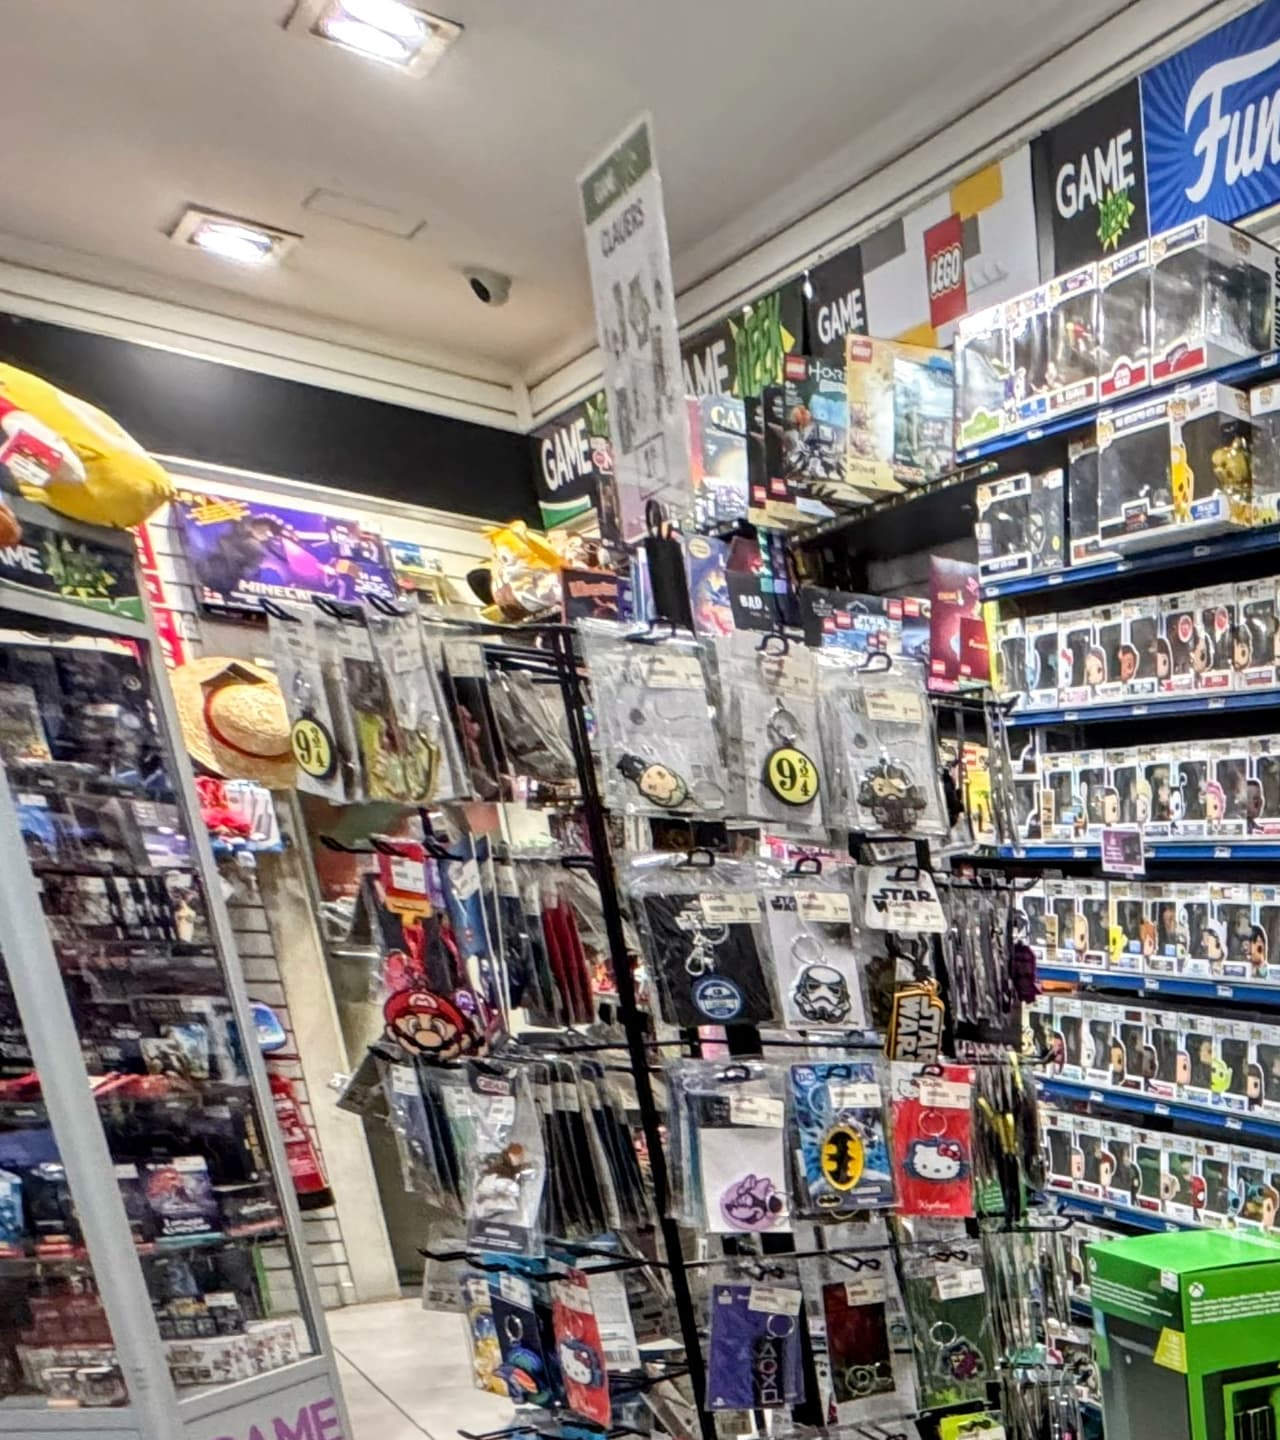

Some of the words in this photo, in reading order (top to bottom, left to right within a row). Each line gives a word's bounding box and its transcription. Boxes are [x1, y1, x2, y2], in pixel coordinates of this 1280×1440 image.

[1056, 129, 1135, 219] GAME
[931, 247, 963, 292] LEGO
[818, 288, 863, 344] GAME
[541, 418, 592, 491] GAME
[873, 888, 935, 902] STAR
